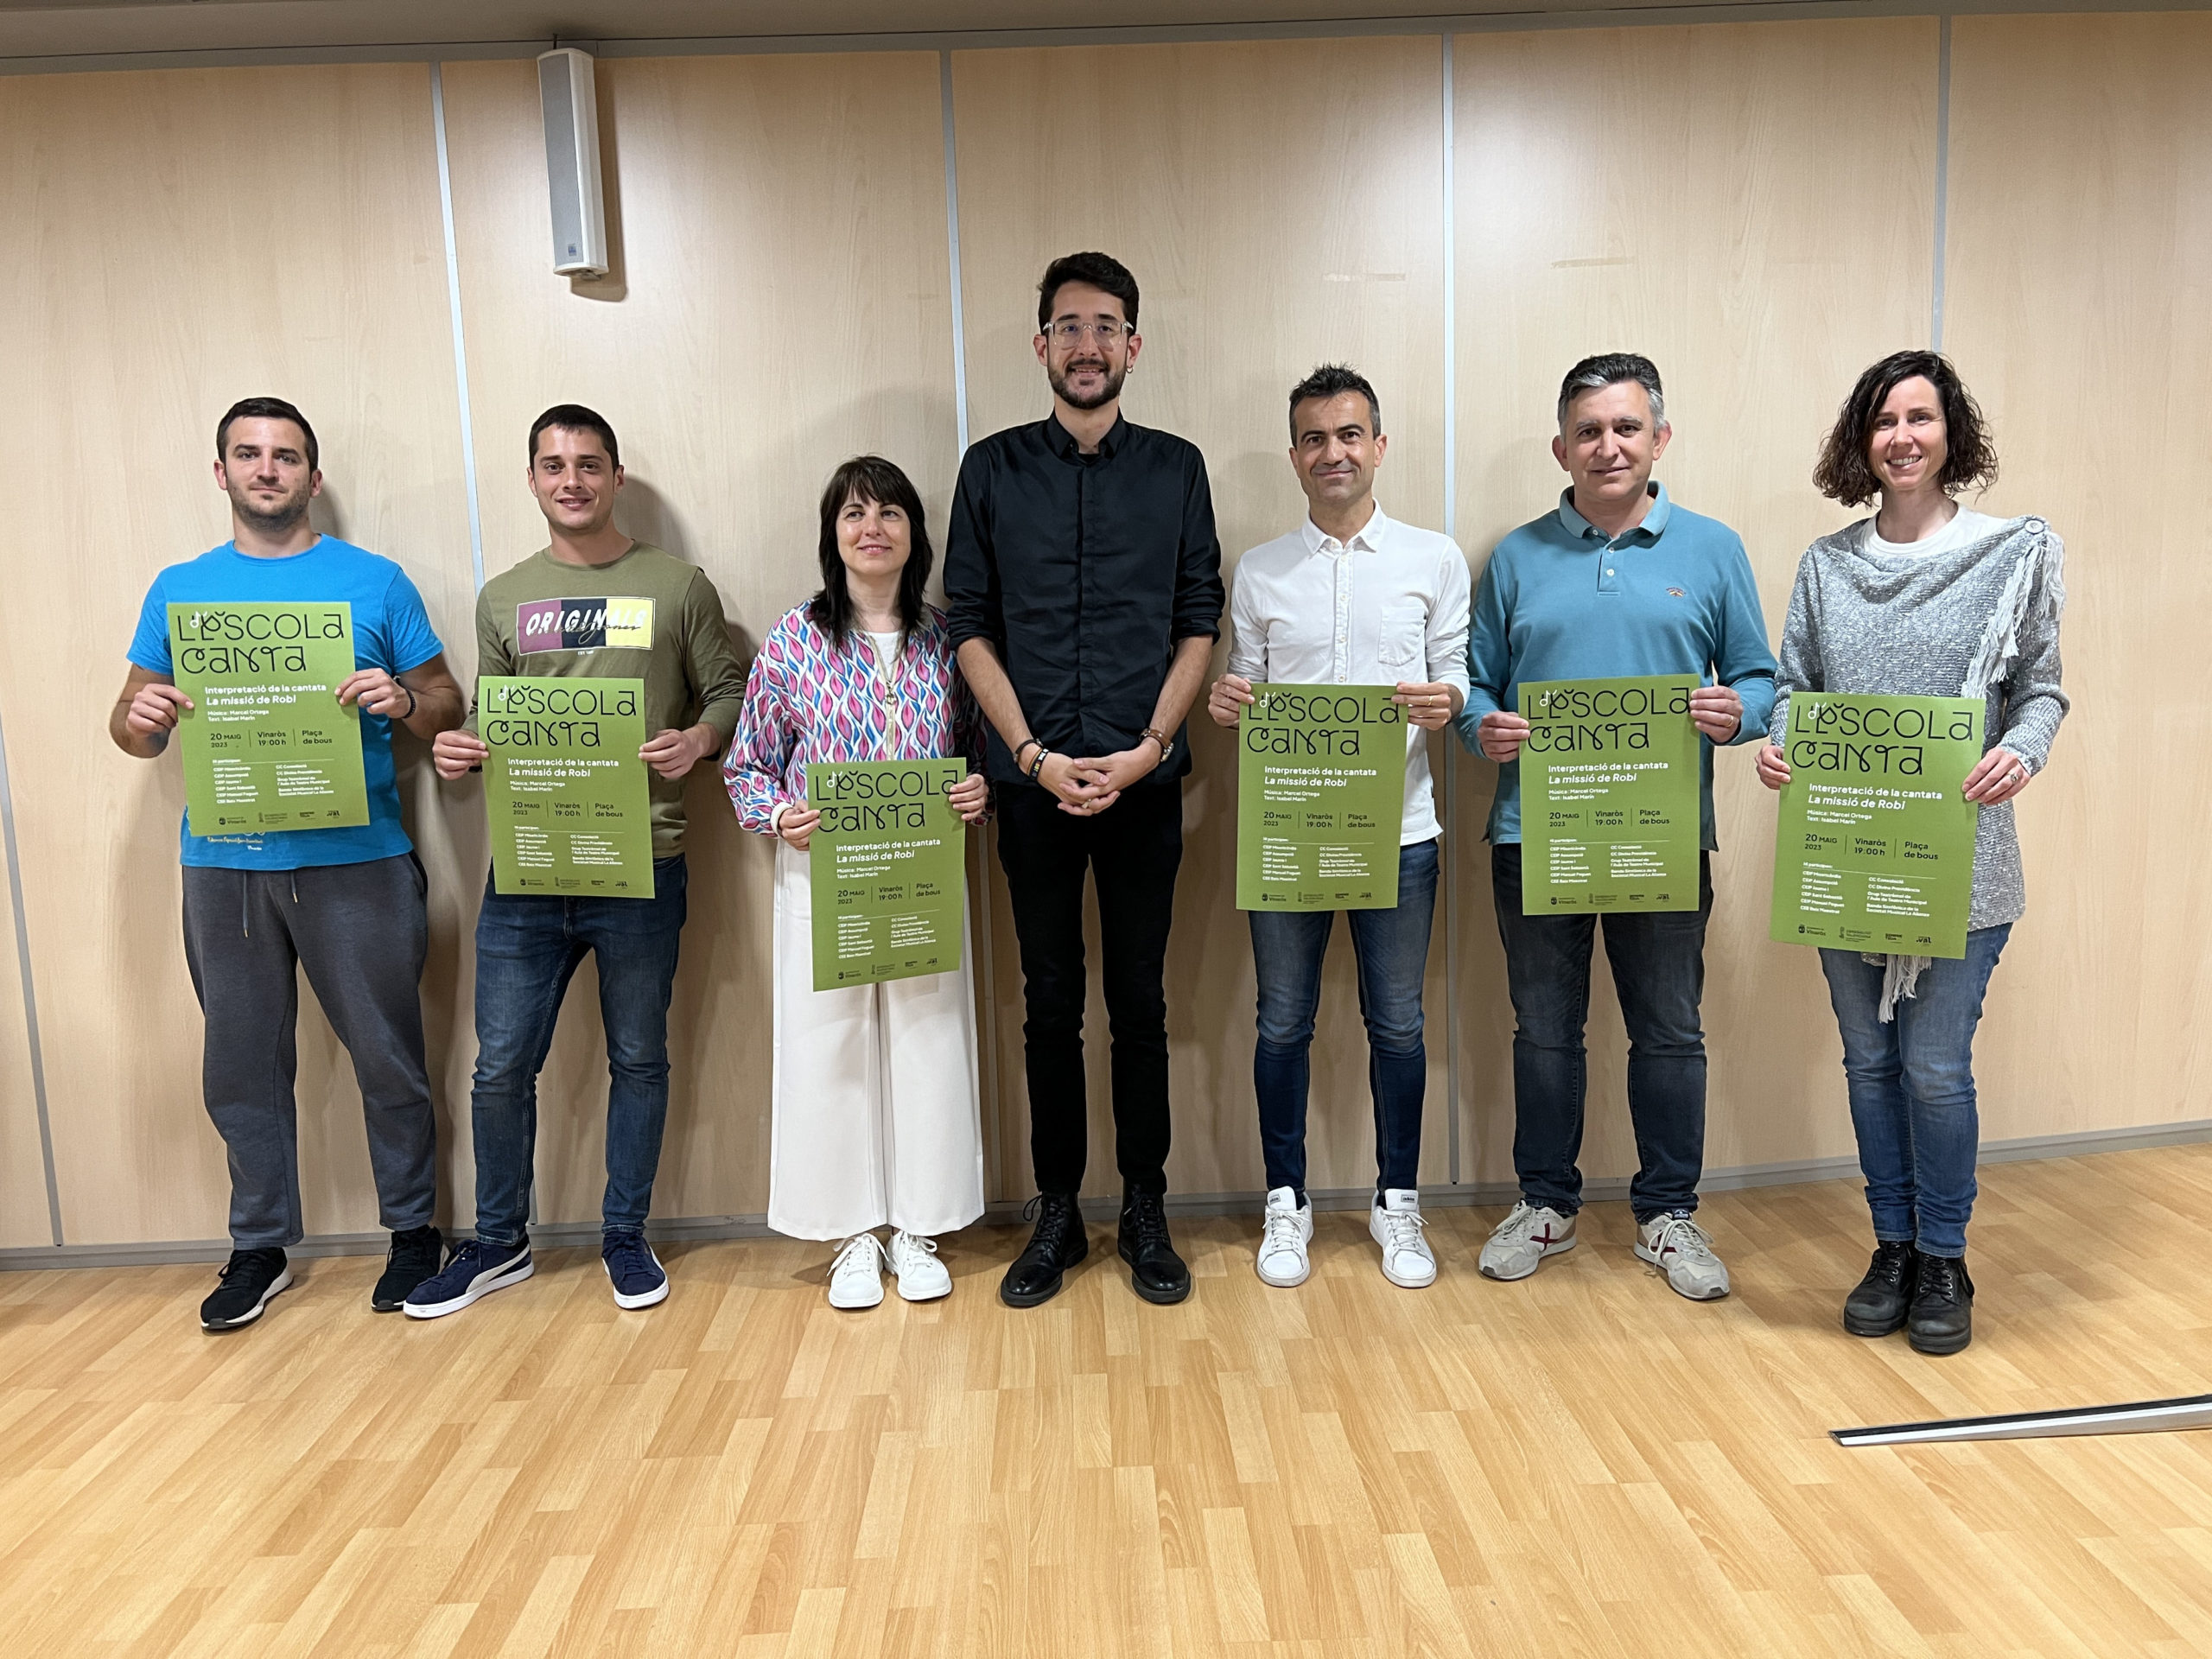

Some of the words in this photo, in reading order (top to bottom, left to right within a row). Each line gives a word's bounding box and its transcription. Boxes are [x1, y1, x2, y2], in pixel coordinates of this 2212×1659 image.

[206, 685, 267, 695] Interpretació
[207, 696, 219, 705] La
[220, 696, 254, 705] missió
[257, 696, 270, 704] de
[272, 695, 296, 703] Robi
[508, 758, 564, 766] Interpretació
[1266, 766, 1320, 775] Interpretació
[1548, 763, 1608, 773] Interpretació
[1562, 774, 1595, 784] missió
[1613, 772, 1637, 782] Robi
[1809, 783, 1874, 796] Interpretació
[1876, 788, 1889, 797] de
[1902, 791, 1942, 799] cantata
[1808, 795, 1821, 804] La
[1822, 796, 1859, 806] missió
[1860, 798, 1876, 808] de
[1878, 799, 1905, 810] Robi
[1640, 809, 1660, 817] Plaça
[836, 841, 890, 854] Interpretació
[912, 839, 941, 848] cantata
[1855, 837, 1886, 846] Vinaròs
[1904, 842, 1929, 851] Plaça
[837, 855, 847, 863] La
[849, 852, 879, 862] missió
[880, 851, 893, 860] de
[894, 849, 914, 860] Robi
